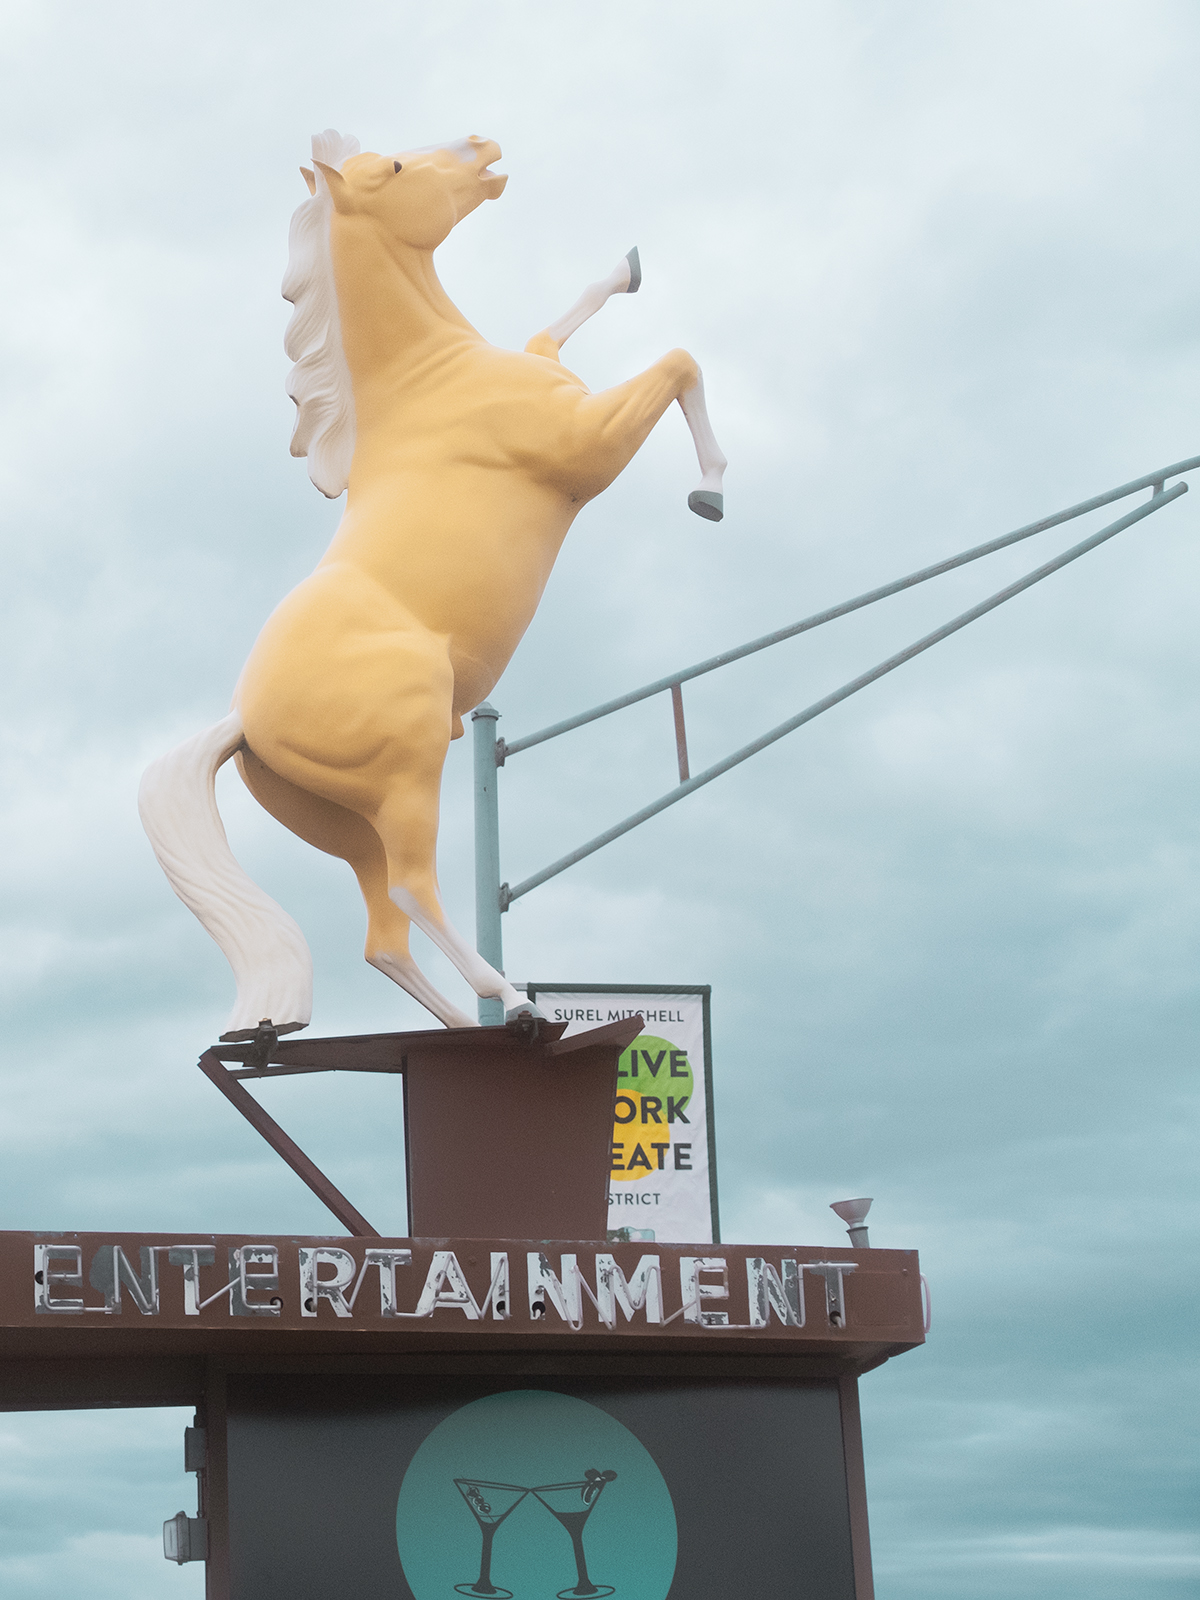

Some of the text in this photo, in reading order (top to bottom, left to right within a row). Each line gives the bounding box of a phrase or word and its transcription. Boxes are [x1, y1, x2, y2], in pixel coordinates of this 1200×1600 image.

[554, 1009, 602, 1021] SUREL
[614, 1096, 690, 1124] ORK
[611, 1143, 692, 1170] EATE
[608, 1193, 660, 1205] STRICT
[34, 1243, 858, 1330] ENTERTAINMENT
